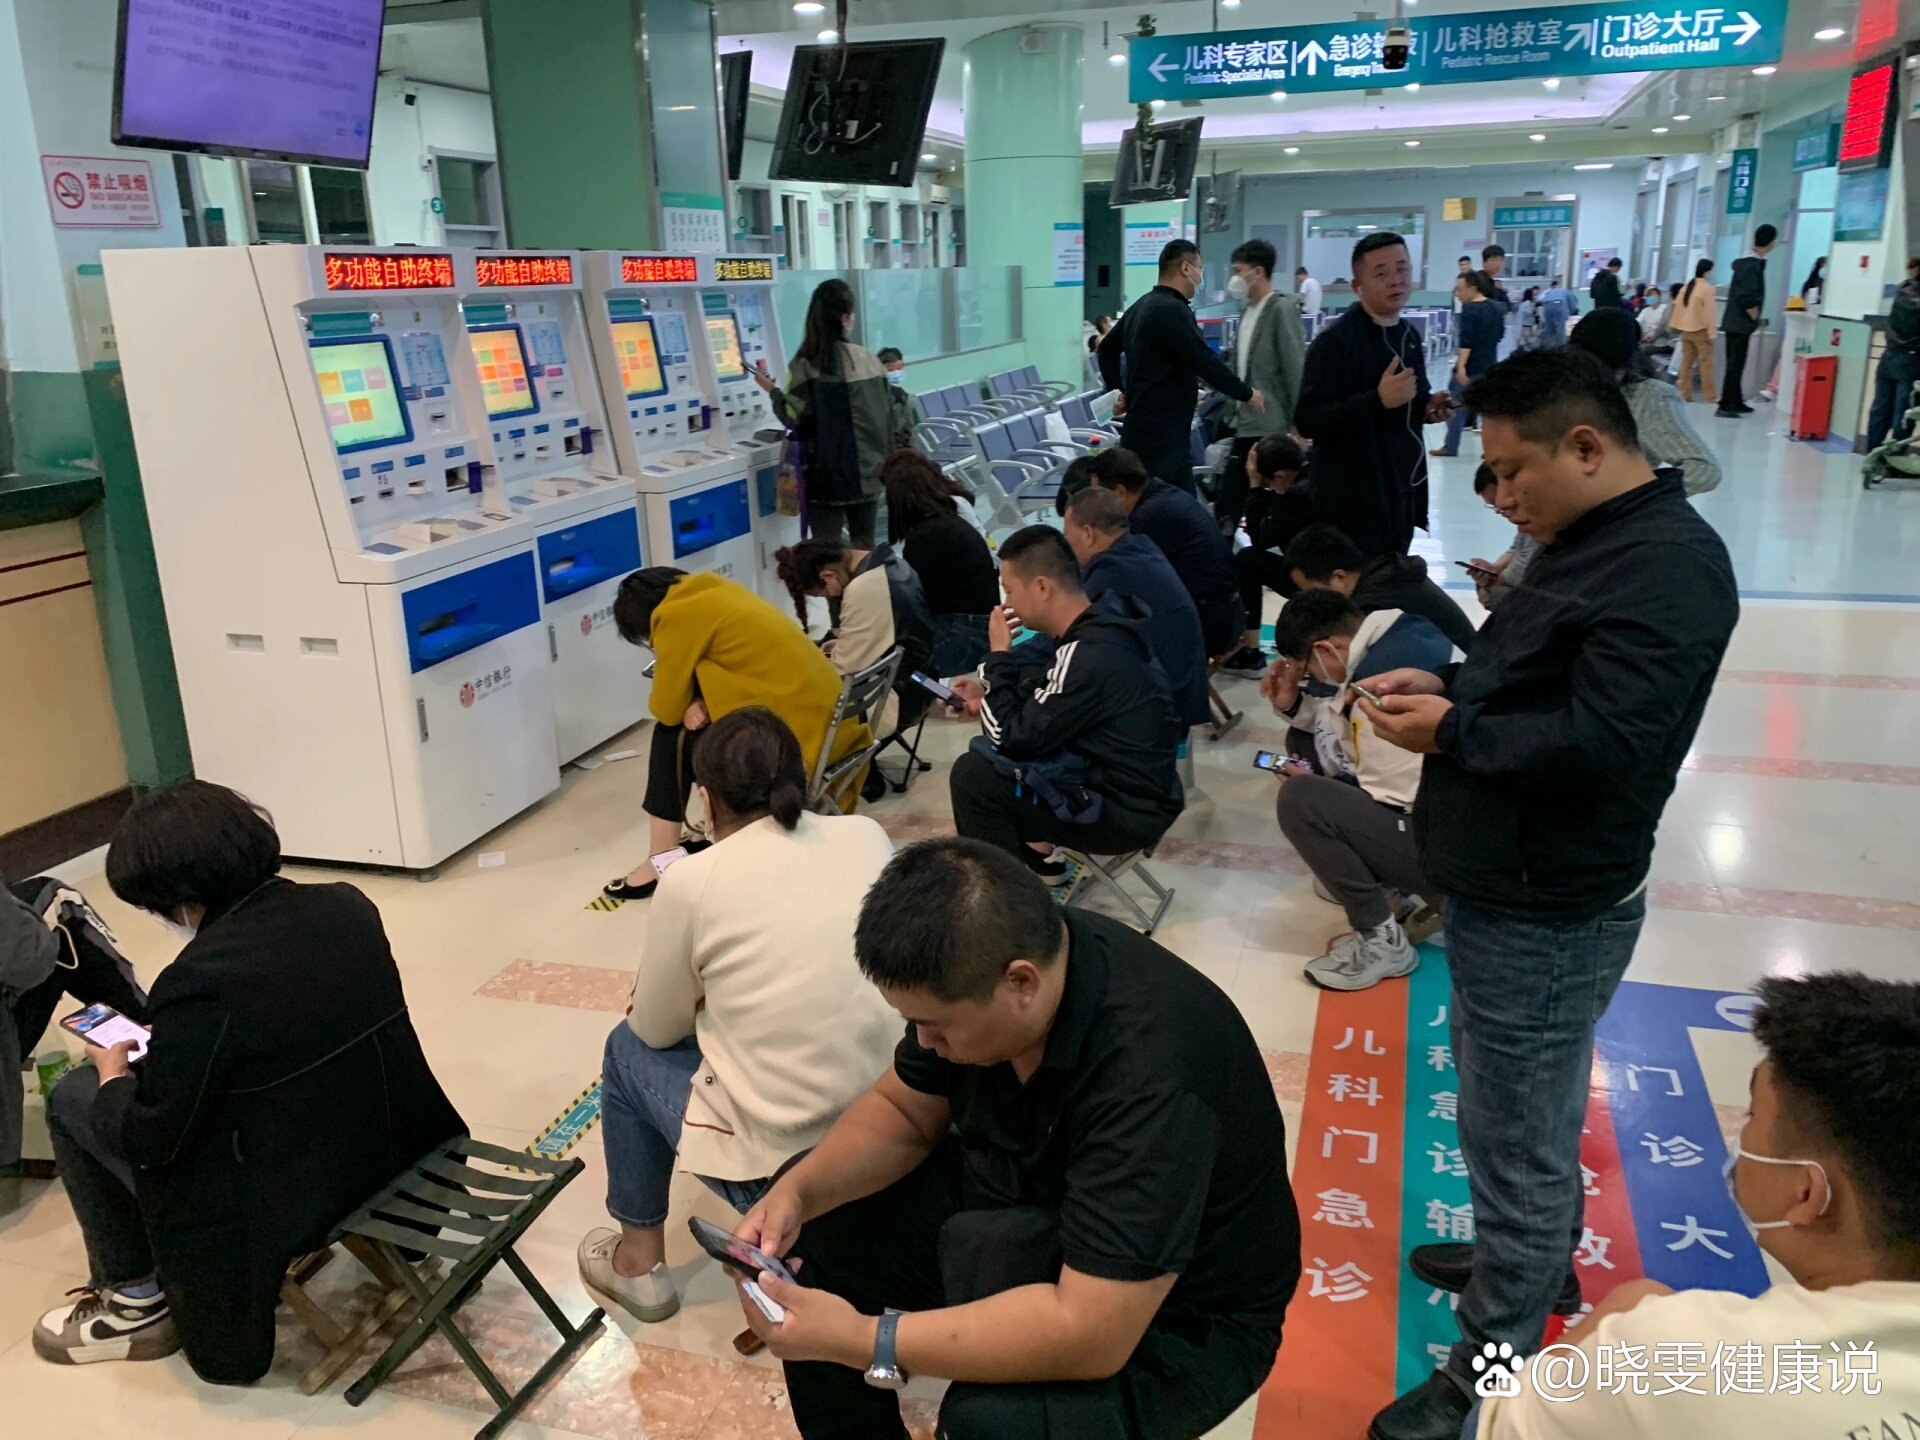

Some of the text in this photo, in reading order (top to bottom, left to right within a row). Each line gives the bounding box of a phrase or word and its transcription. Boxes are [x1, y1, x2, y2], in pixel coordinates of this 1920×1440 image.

[1433, 19, 1563, 53] 儿科抢救室
[1602, 9, 1724, 43] 门诊大厅
[1183, 39, 1289, 70] 儿科专家区
[1441, 50, 1551, 69] Pediatric Rescue Room
[1601, 38, 1720, 59] Outpatient Hall
[1183, 67, 1286, 85] Pediatric Specialist Area
[86, 172, 148, 191] 禁止吸烟
[326, 257, 452, 289] 多功能自助终端
[476, 258, 571, 286] 多功能自助终端
[622, 258, 696, 281] 多功能自助终端
[715, 260, 772, 280] 多功能自助终端
[537, 1087, 602, 1150] 请在一米
[1304, 1026, 1387, 1302] 儿科门急诊
[1626, 1063, 1735, 1261] 门诊大
